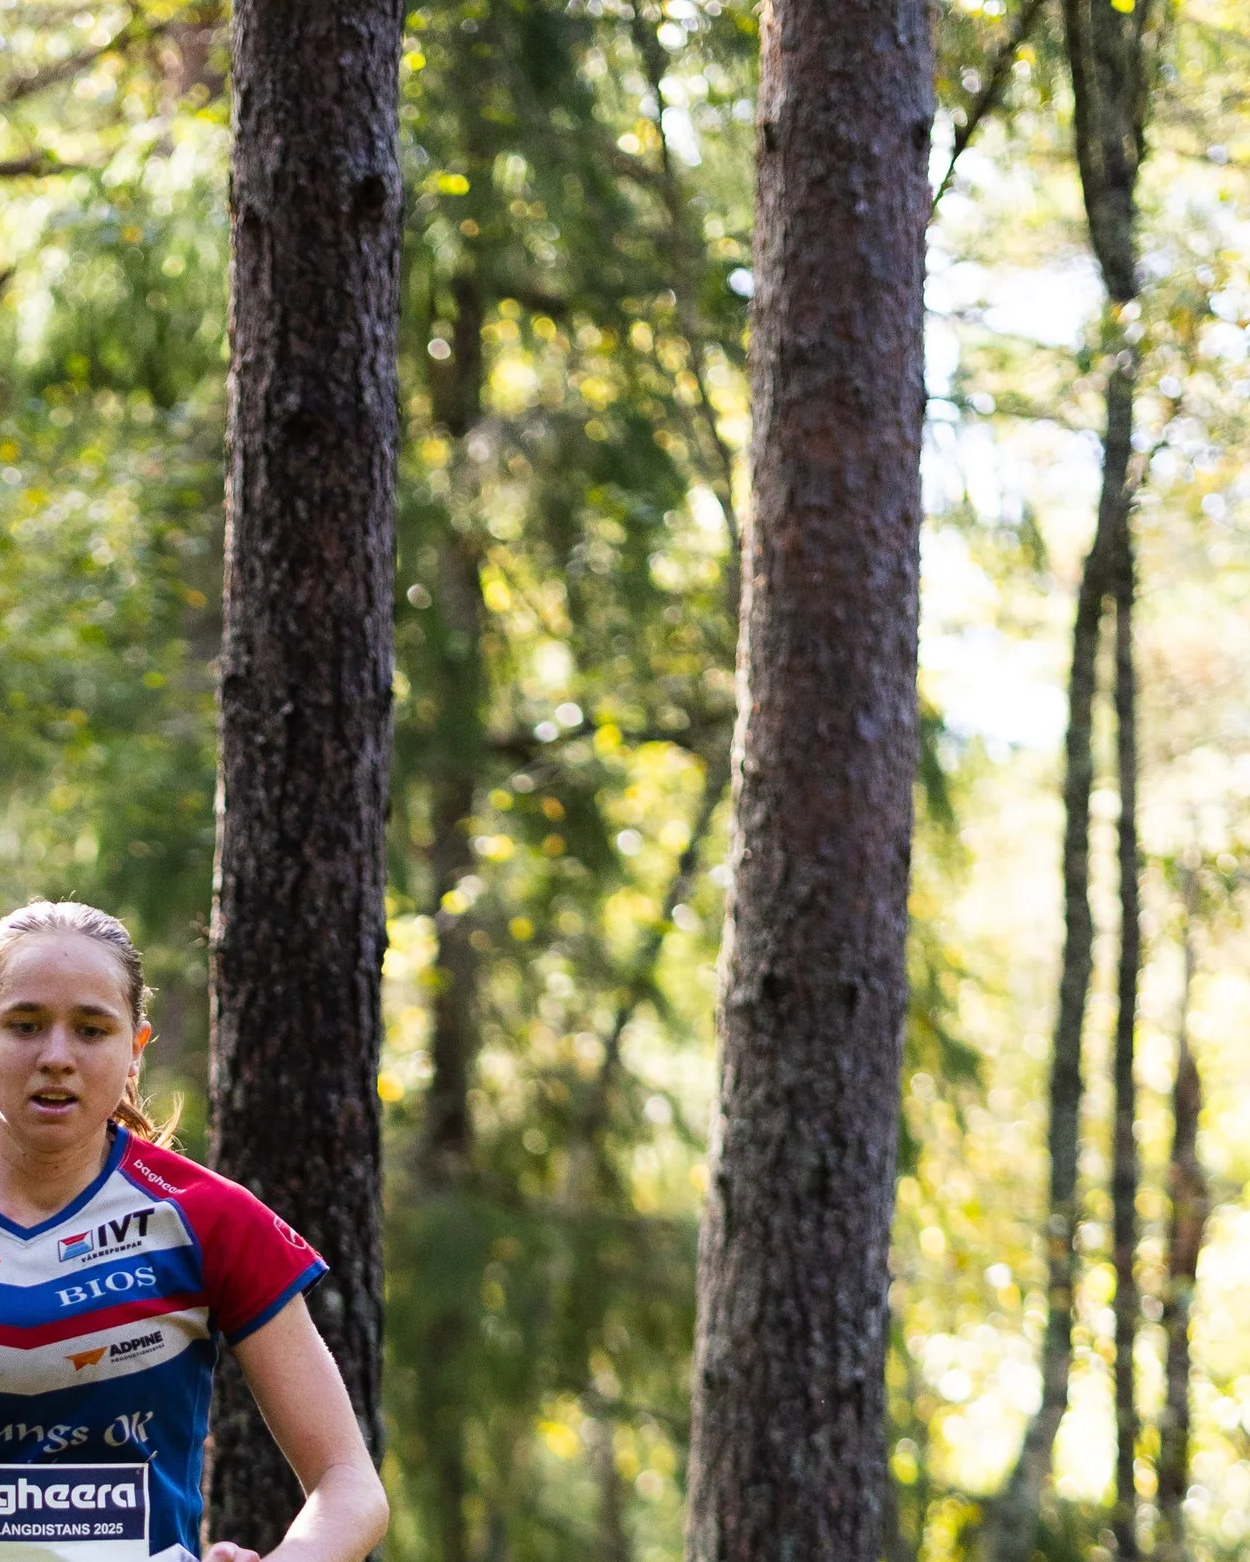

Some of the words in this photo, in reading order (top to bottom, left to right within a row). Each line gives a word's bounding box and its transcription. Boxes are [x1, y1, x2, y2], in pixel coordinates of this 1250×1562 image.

[133, 1159, 187, 1194] baghee
[98, 1208, 155, 1248] IVT
[54, 1266, 157, 1307] BIOS
[110, 1330, 163, 1356] ADPINE
[93, 1522, 124, 1535] 2025
